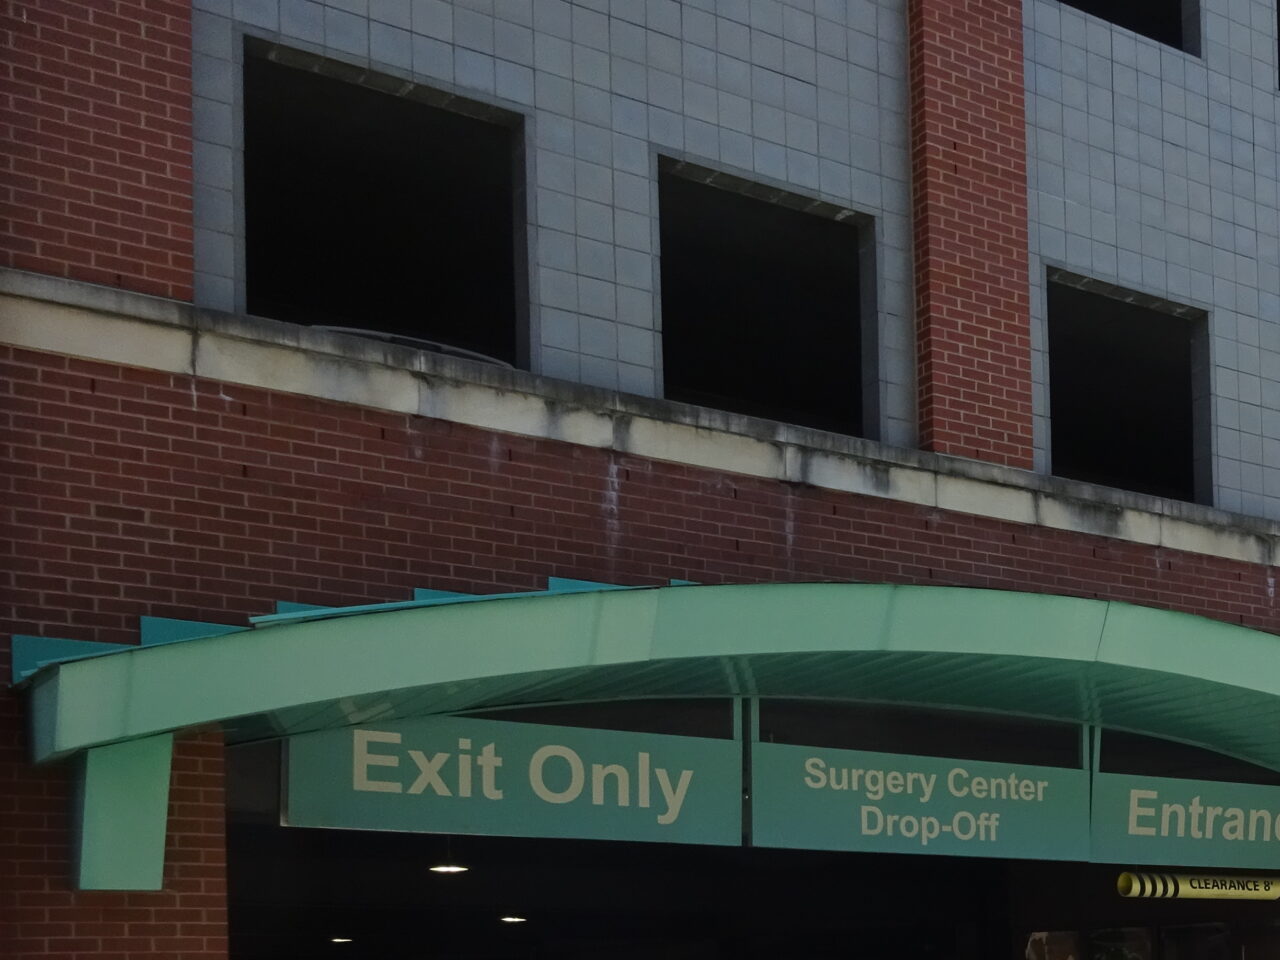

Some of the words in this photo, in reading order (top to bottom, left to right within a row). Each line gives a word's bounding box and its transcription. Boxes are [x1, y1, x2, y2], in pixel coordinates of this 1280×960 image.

[352, 728, 503, 801] Exit
[529, 744, 693, 825] Only
[804, 757, 938, 803] Surgery
[946, 767, 1048, 802] Center
[861, 805, 1000, 845] Drop-Off
[1189, 878, 1260, 891] CLEARANCE
